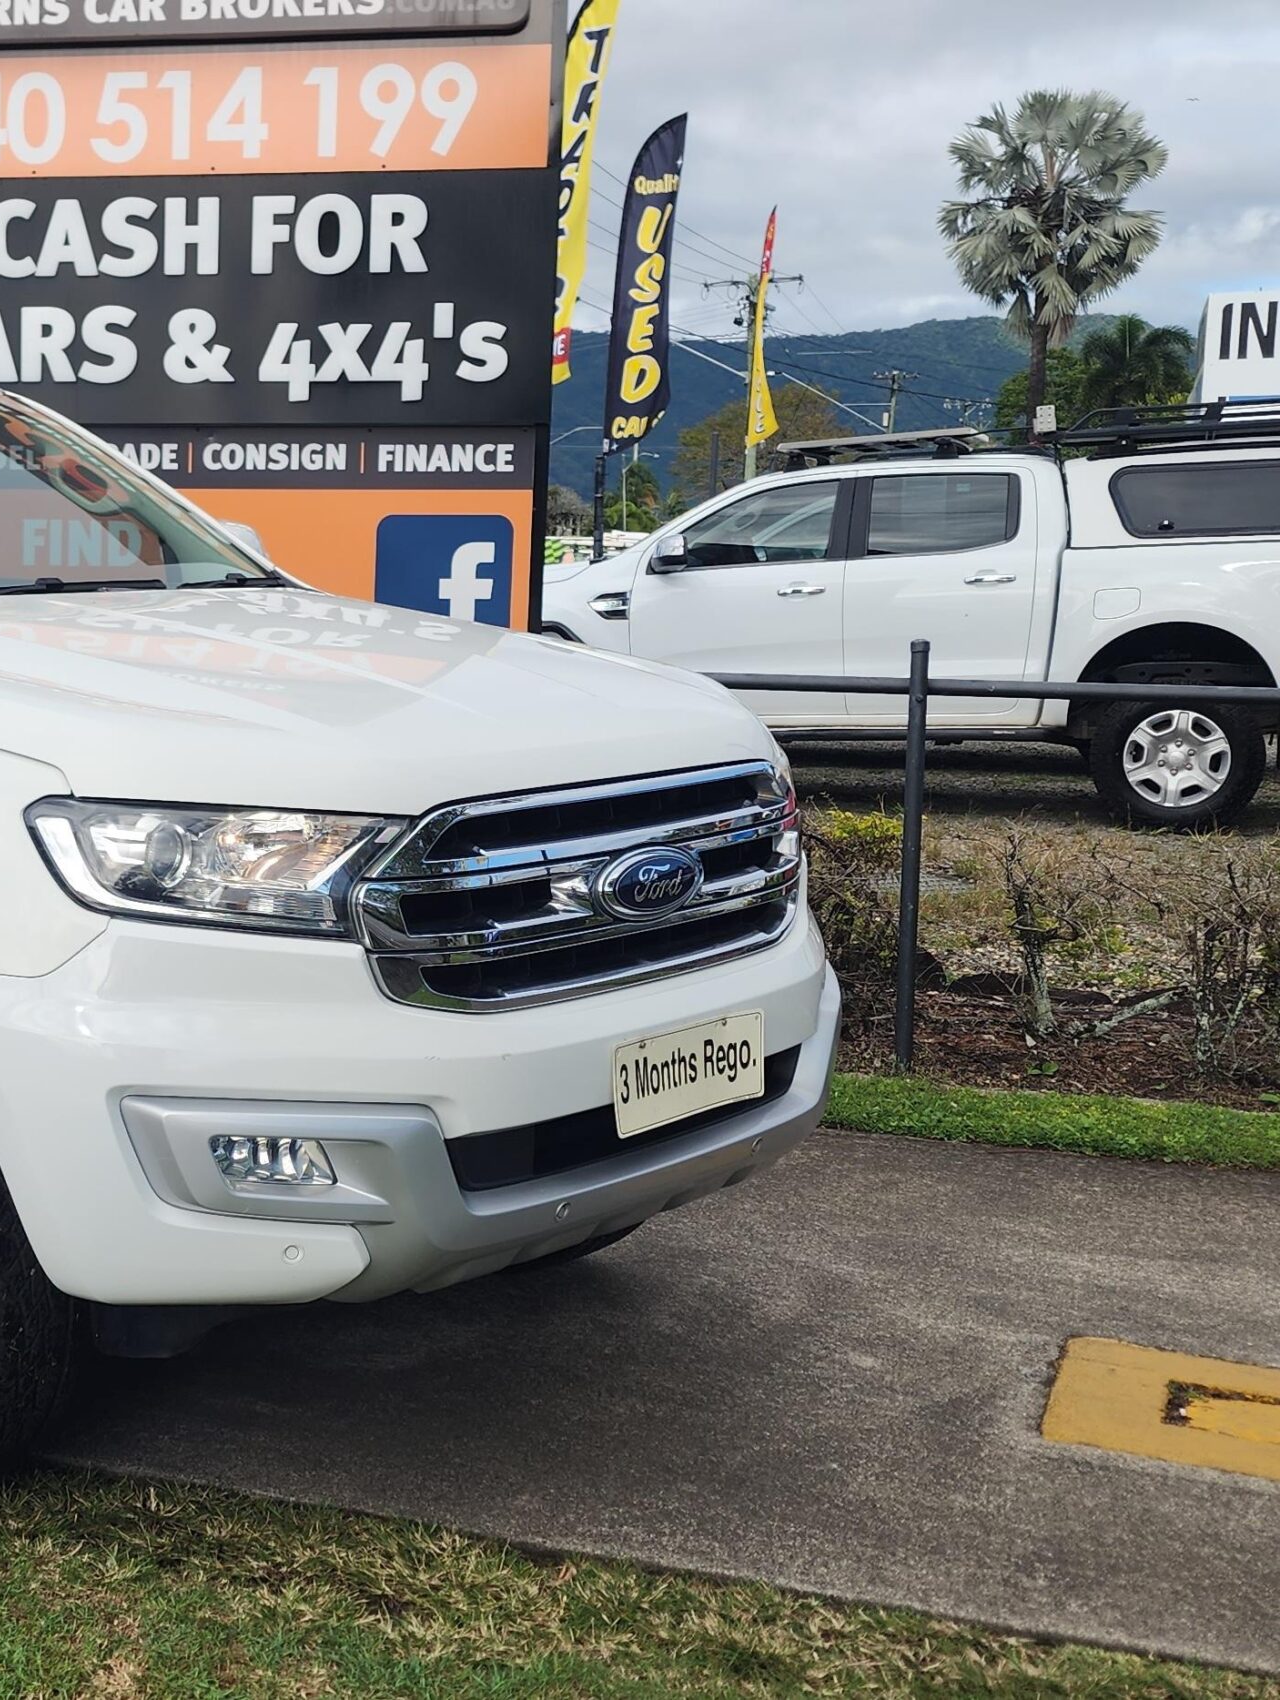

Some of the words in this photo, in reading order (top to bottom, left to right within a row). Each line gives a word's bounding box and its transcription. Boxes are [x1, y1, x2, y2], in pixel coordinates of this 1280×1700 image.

[84, 0, 166, 23] CAR
[90, 67, 268, 161] 514
[304, 61, 478, 157] 199
[250, 193, 428, 275] FOR
[620, 203, 673, 404] USED
[163, 307, 234, 383] &
[114, 443, 179, 471] ADE
[203, 442, 347, 471] CONSIGN
[378, 443, 514, 473] FINANCE
[23, 519, 142, 567] FIND
[634, 864, 683, 903] Ford
[620, 1064, 630, 1104] 3
[635, 1047, 698, 1099] Months
[704, 1039, 756, 1083] Rego.
